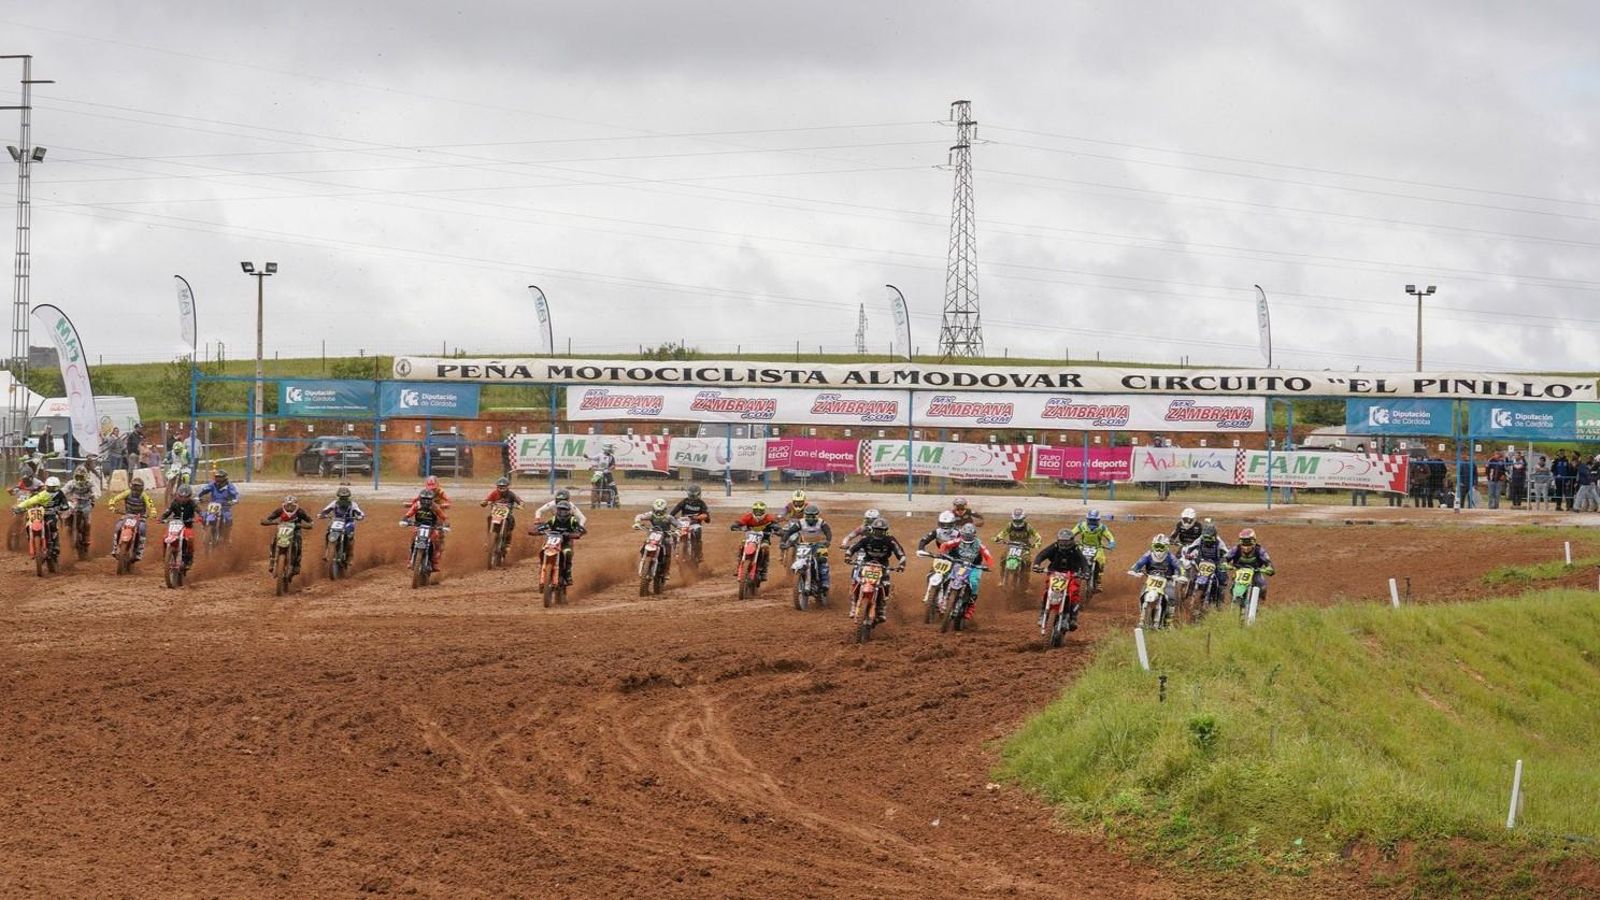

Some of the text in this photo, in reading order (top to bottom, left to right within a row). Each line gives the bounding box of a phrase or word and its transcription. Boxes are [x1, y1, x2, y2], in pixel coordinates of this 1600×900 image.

[437, 361, 533, 379] PEÑA
[547, 365, 829, 384] MOTOCICLISTA
[841, 370, 1084, 388] ALMODOVAR
[1121, 375, 1311, 391] CIRCUITO
[580, 395, 664, 410] ZAMBRANA
[690, 398, 777, 413] ZAMBRANA
[810, 400, 898, 416] ZAMBRANA
[926, 402, 1014, 417] ZAMBRANA
[1041, 405, 1130, 420] ZAMBRANA
[1164, 407, 1254, 422] ZAMBRANA
[1392, 410, 1431, 419] Diputación
[1515, 413, 1553, 421] Diputación
[520, 438, 586, 457] FAM
[794, 449, 854, 461] con el deporte
[874, 444, 944, 464] FAM
[675, 452, 708, 463] FAM
[1039, 460, 1060, 468] RECIO
[1091, 459, 1128, 470] deporte
[1144, 451, 1227, 471] Andalucía
[1248, 455, 1320, 474] FAM
[1052, 578, 1067, 588] 27
[1150, 579, 1164, 588] 719
